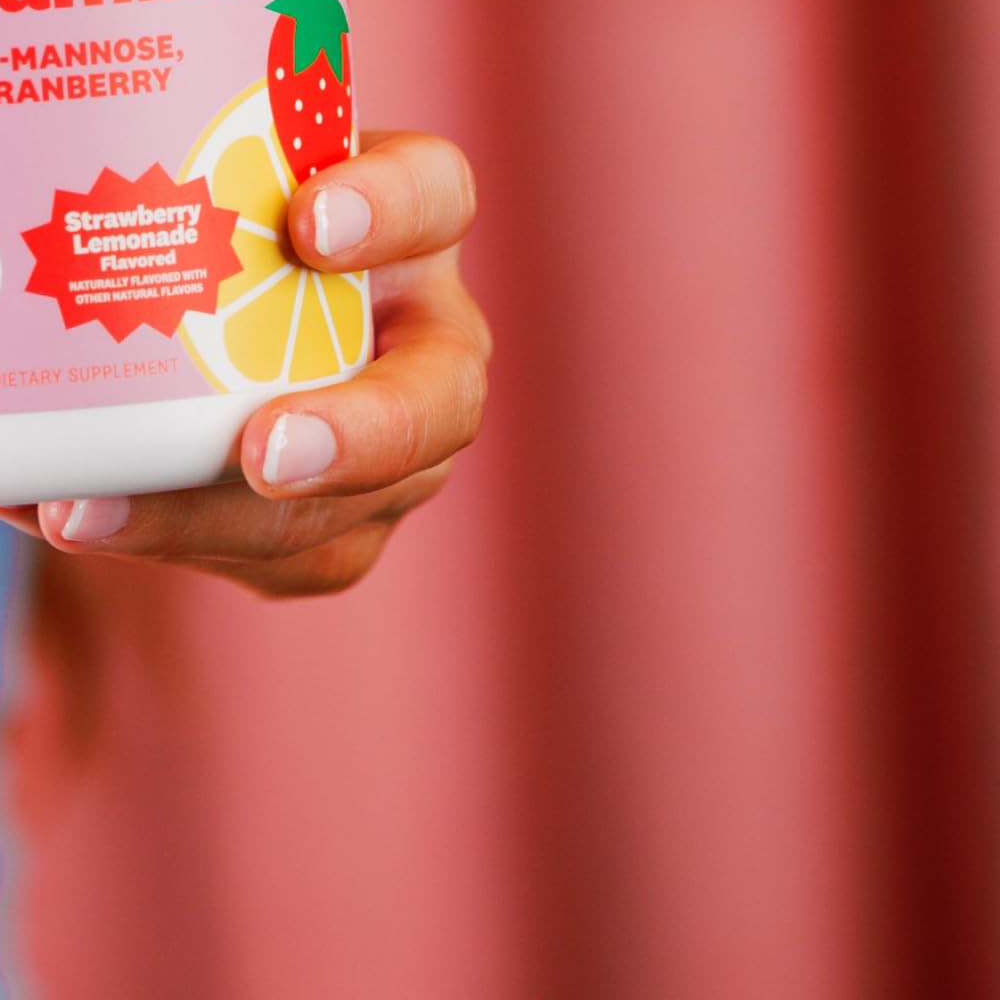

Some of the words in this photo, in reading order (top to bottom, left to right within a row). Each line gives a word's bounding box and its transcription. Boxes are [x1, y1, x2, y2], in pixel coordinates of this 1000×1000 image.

[64, 203, 201, 233] Strawberry
[72, 223, 198, 255] Lemonade
[100, 249, 177, 272] Flavored
[68, 276, 129, 292] NATURALLY
[130, 271, 182, 287] FLAVORED
[183, 269, 207, 280] WITH
[75, 293, 111, 306] OTHER
[113, 288, 159, 302] NATURAL
[161, 283, 204, 297] FLAVORS
[67, 357, 179, 383] SUPPLEMENT
